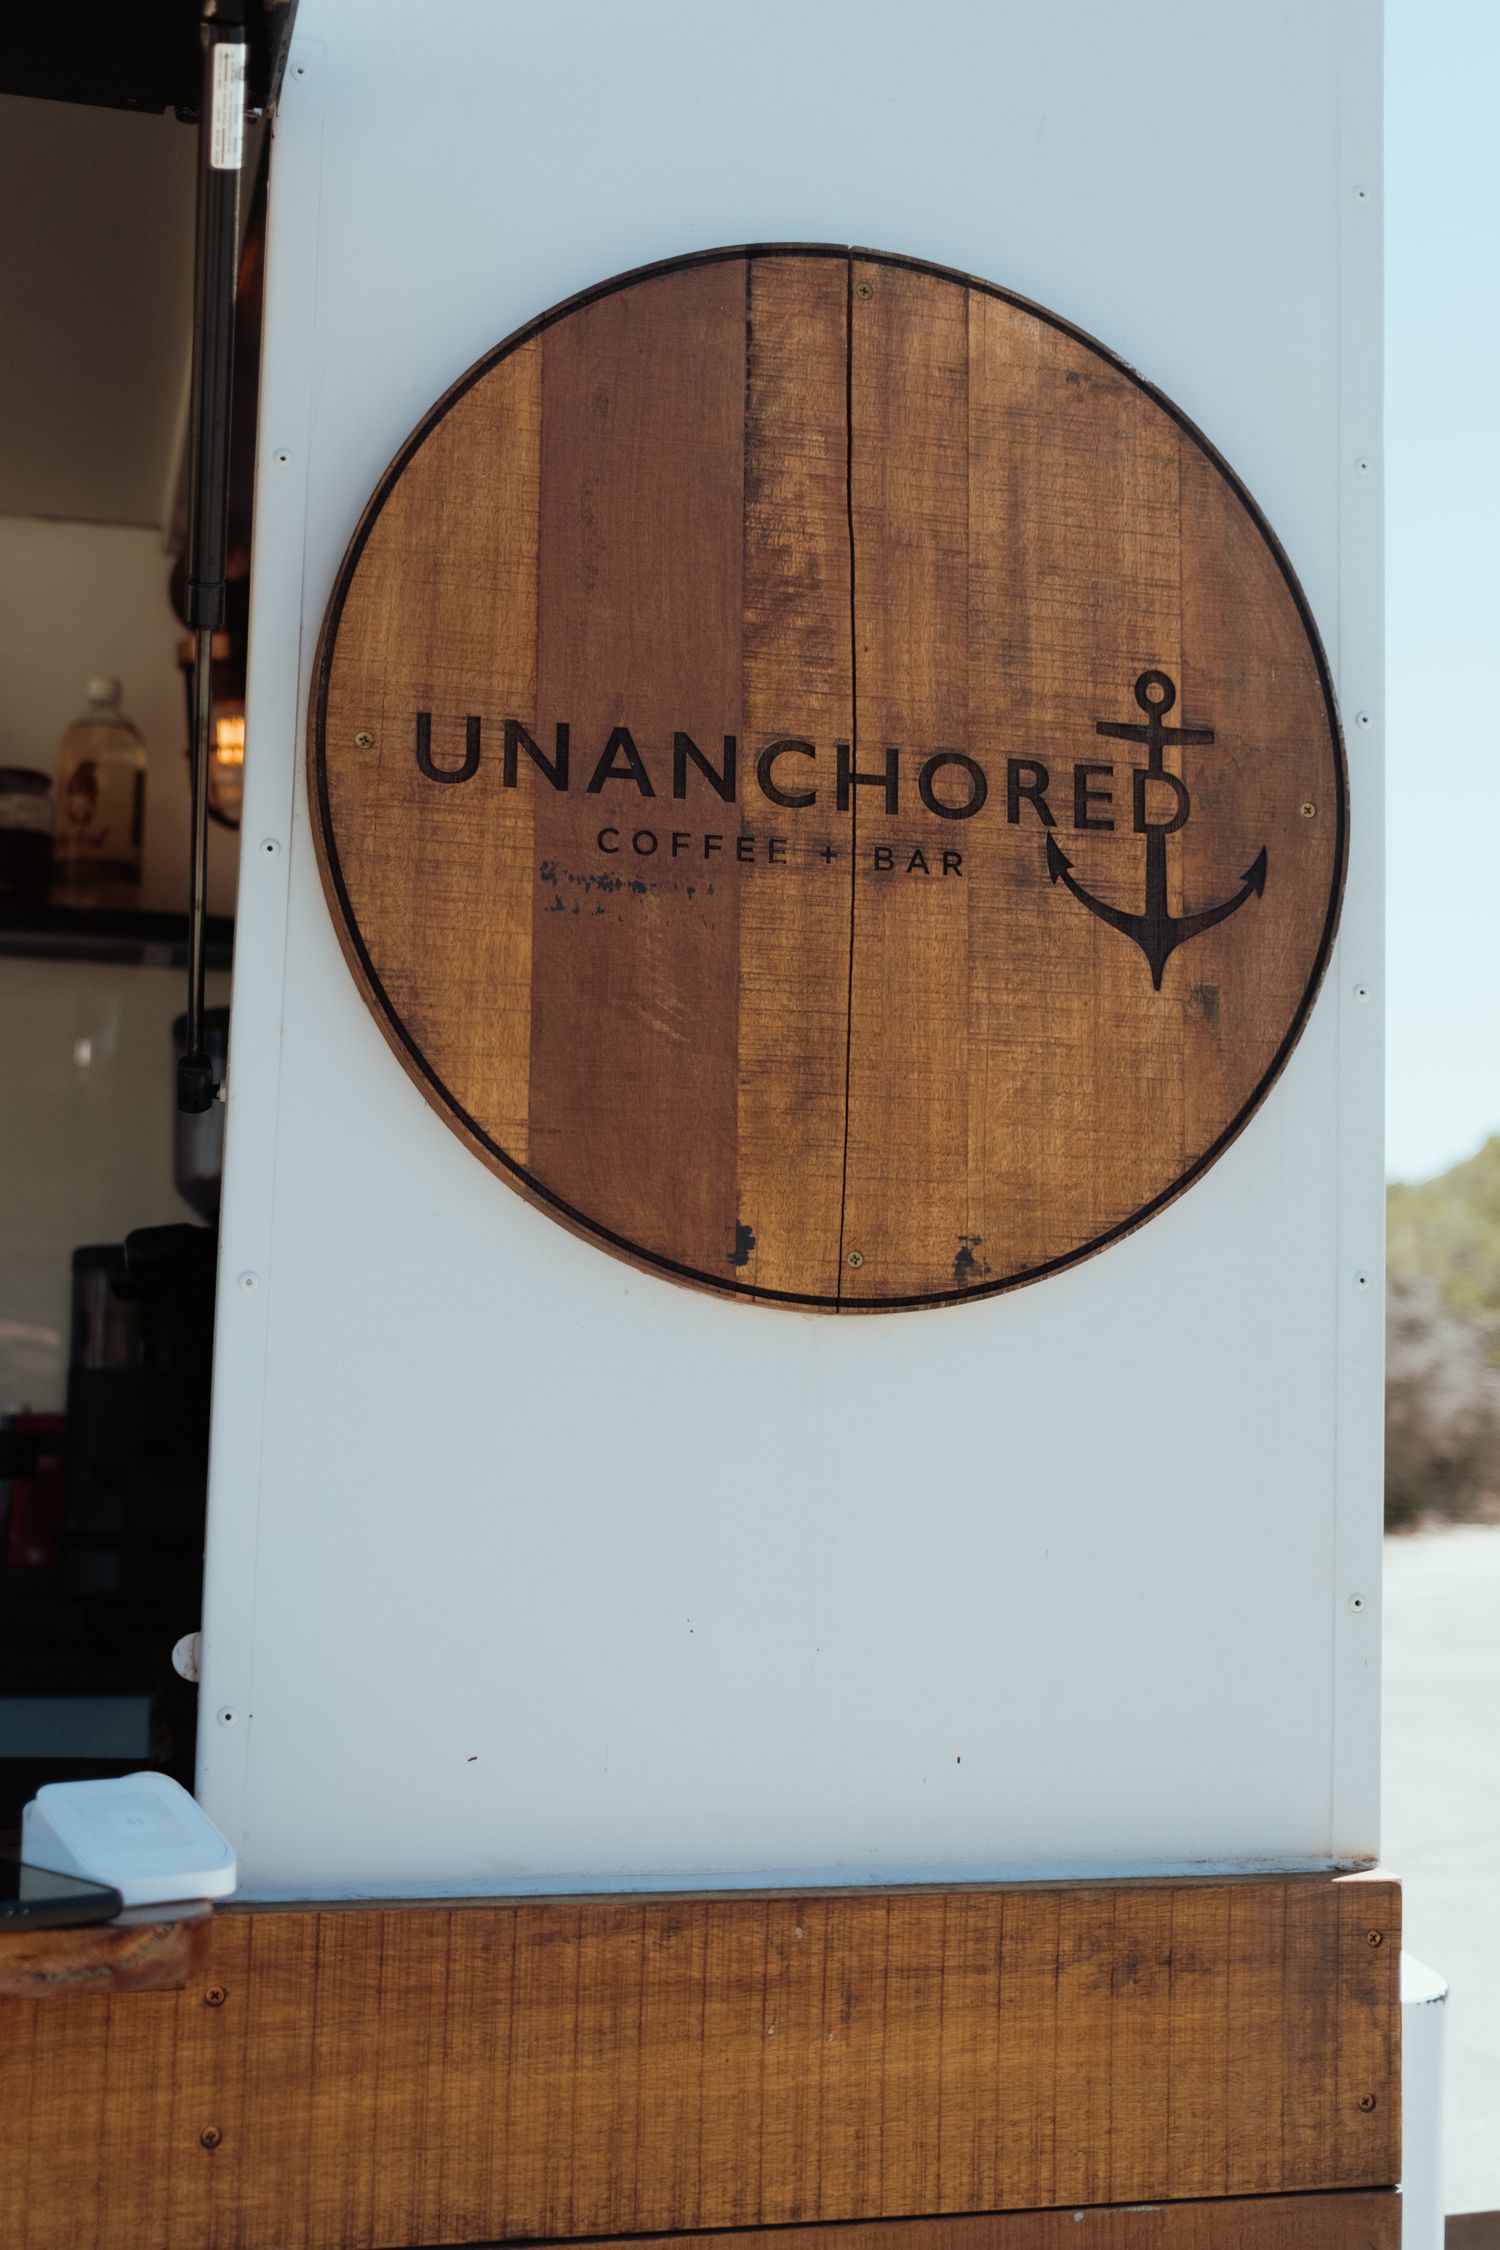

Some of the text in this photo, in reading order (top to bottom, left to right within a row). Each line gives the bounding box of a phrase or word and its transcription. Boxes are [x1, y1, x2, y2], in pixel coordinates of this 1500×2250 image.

[416, 712, 1191, 833] UNANCHORED
[597, 828, 964, 876] COFFEE + BAR
